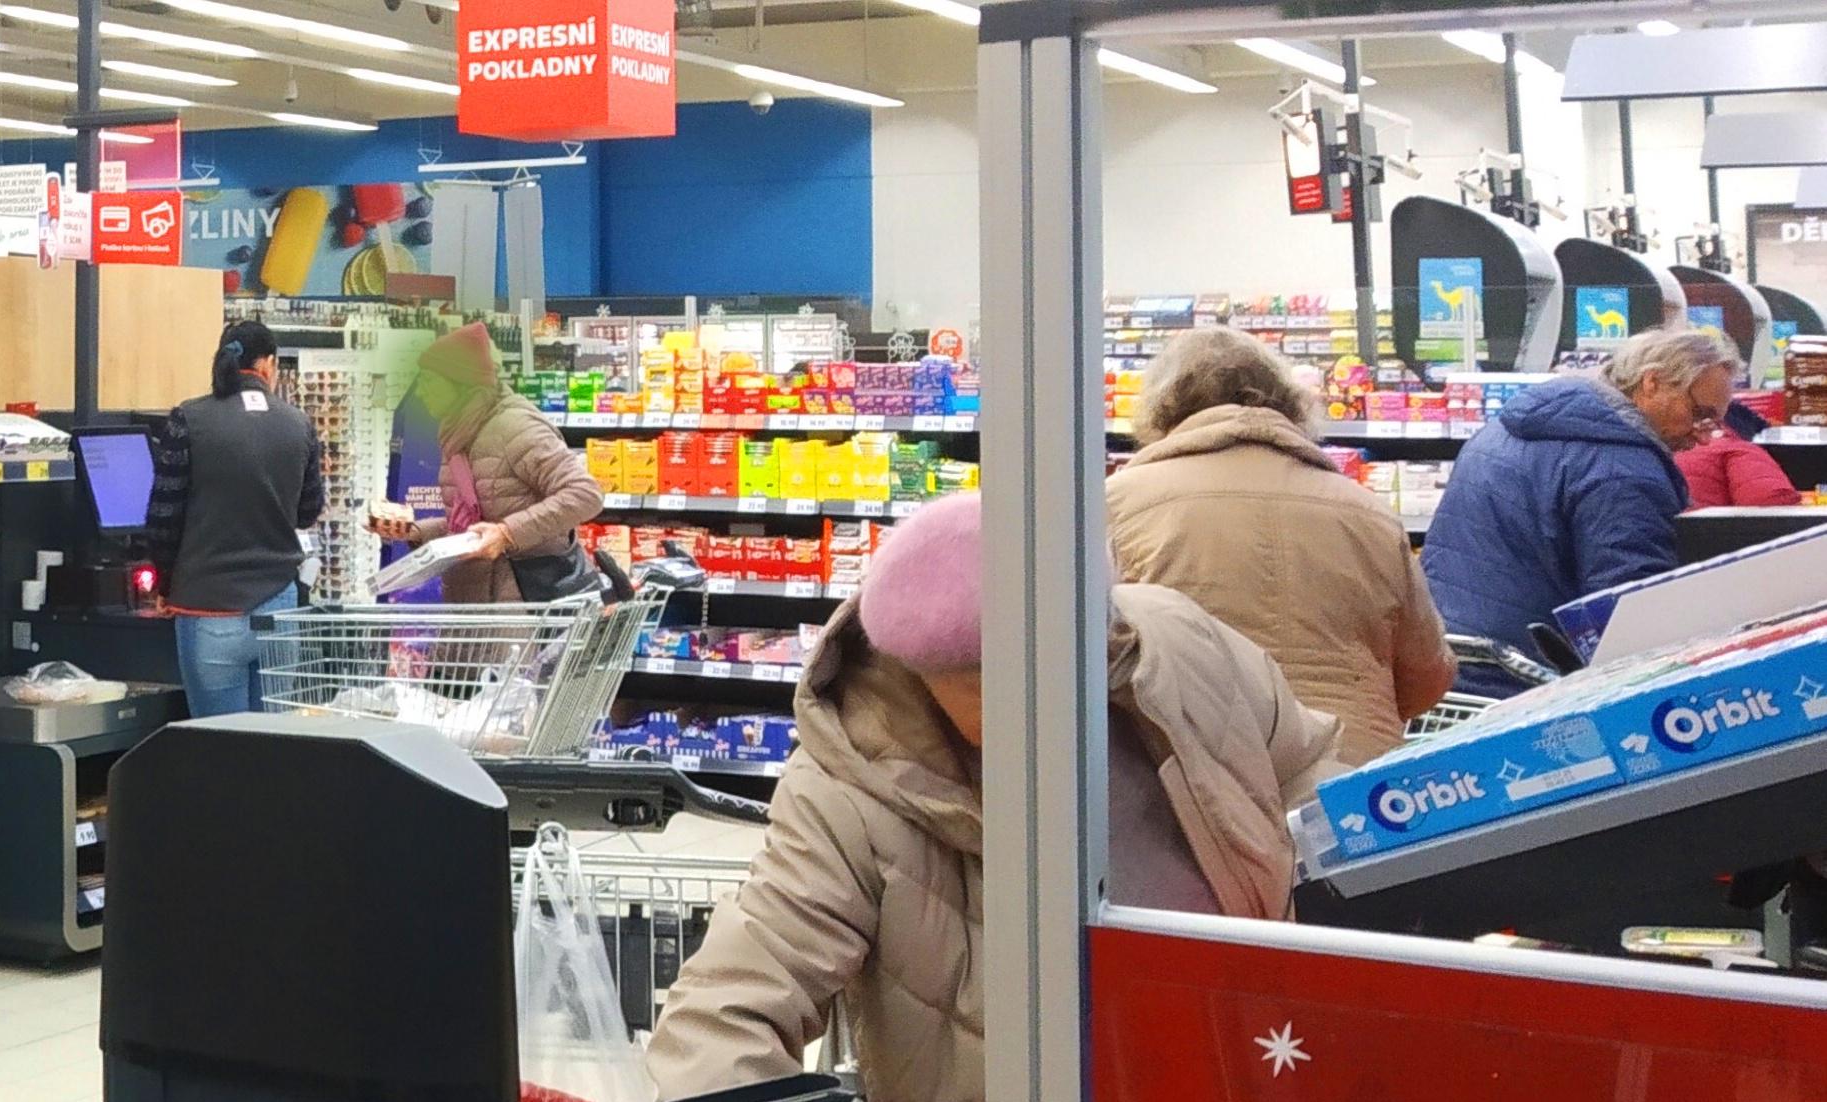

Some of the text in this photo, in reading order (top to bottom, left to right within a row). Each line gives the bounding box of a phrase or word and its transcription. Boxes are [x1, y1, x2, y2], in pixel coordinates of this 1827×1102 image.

[468, 17, 596, 53] EXPRESNÍ
[611, 23, 670, 57] EXPRESNÍ
[468, 54, 597, 82] POKLADNY
[611, 55, 670, 85] POKLADNY
[1781, 215, 1827, 243] DĚ
[1664, 687, 1781, 744] Orbit
[1378, 769, 1487, 825] Orbit
